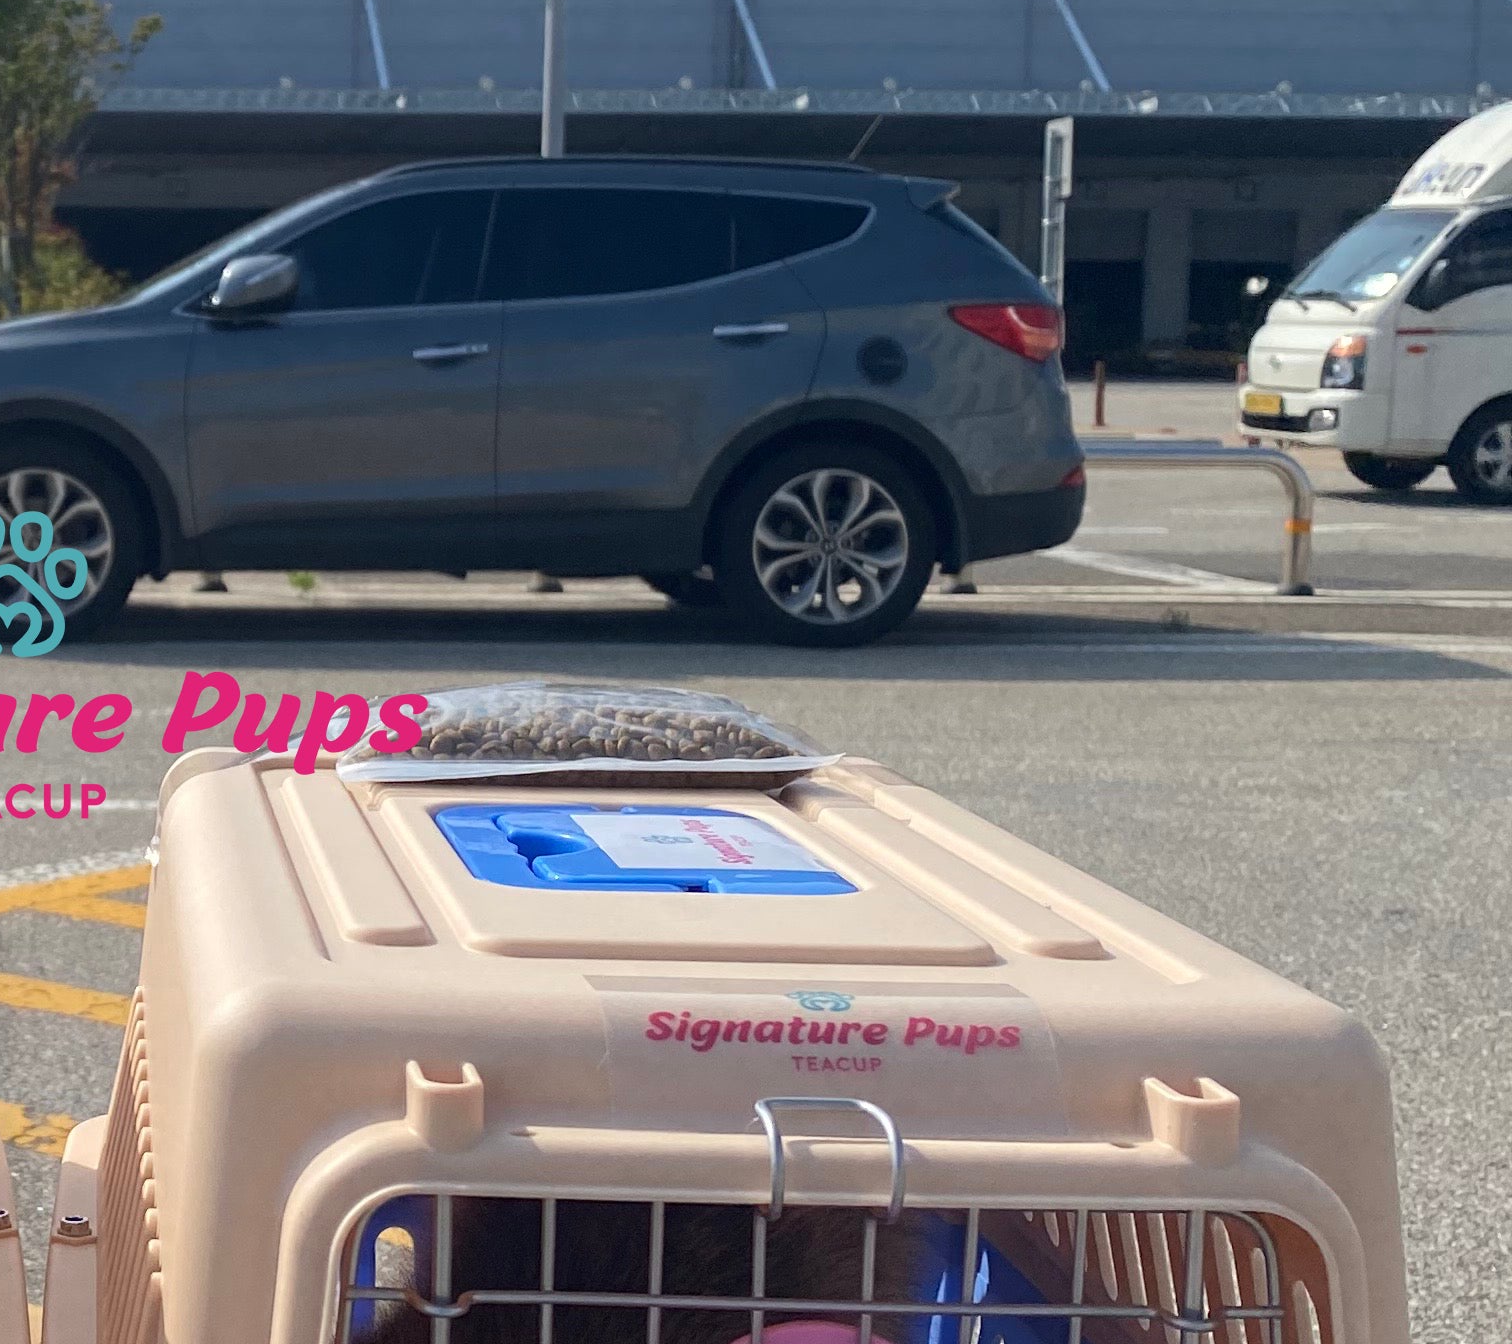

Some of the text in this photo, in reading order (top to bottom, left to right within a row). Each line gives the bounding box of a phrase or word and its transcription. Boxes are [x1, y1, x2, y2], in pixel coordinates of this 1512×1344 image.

[645, 1012, 1021, 1055] Signature Pups
[791, 1056, 883, 1073] TEACUP
